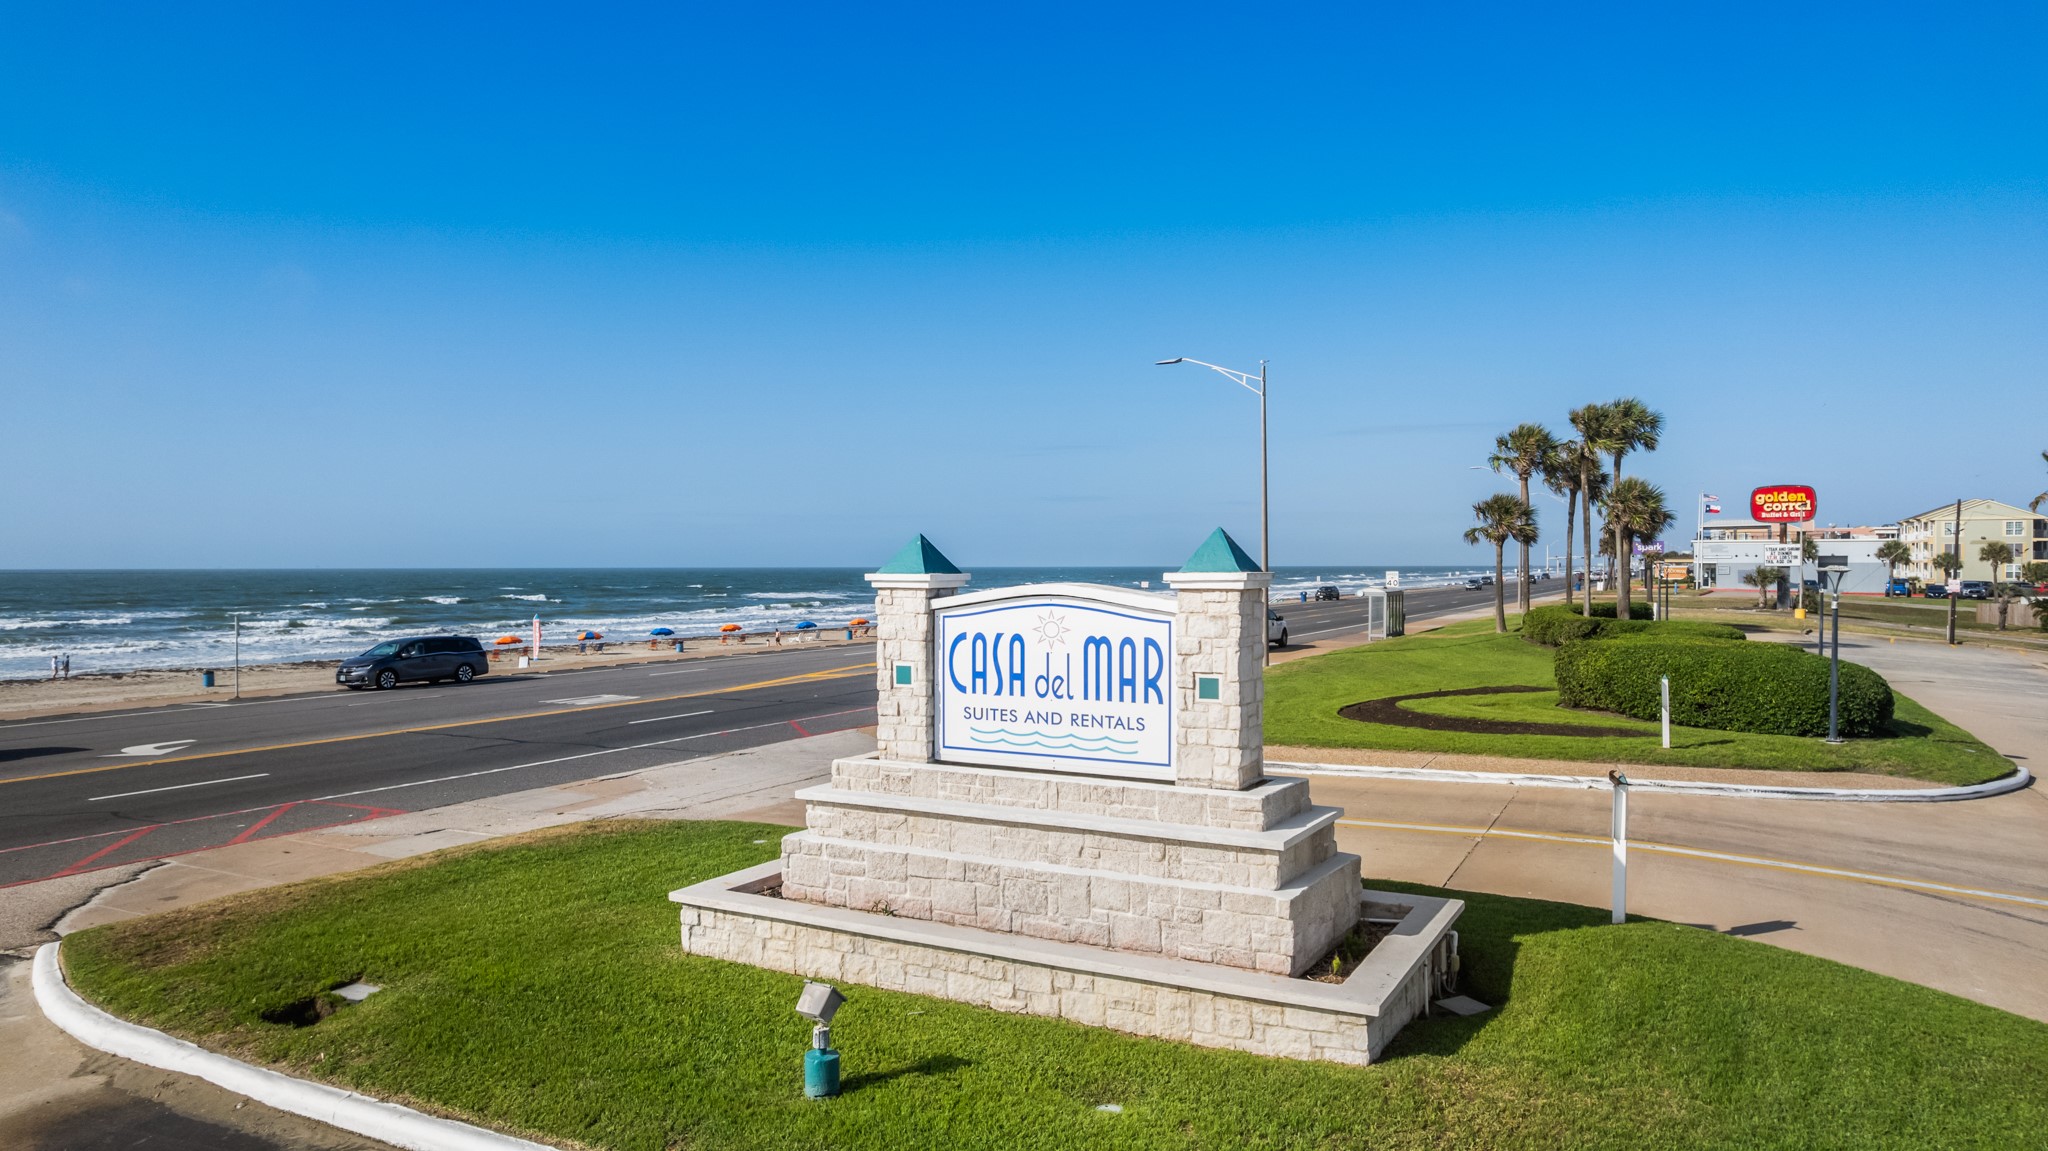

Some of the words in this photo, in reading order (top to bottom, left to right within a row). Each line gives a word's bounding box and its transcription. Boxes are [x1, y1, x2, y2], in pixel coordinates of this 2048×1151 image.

[1755, 491, 1806, 505] golden
[1637, 542, 1662, 552] spark
[949, 632, 1025, 697] CASA
[1035, 652, 1074, 700] del
[1084, 635, 1164, 704] MAR
[963, 706, 1018, 723] SUITES
[1024, 711, 1063, 725] AND
[1071, 713, 1146, 731] RENTALS
